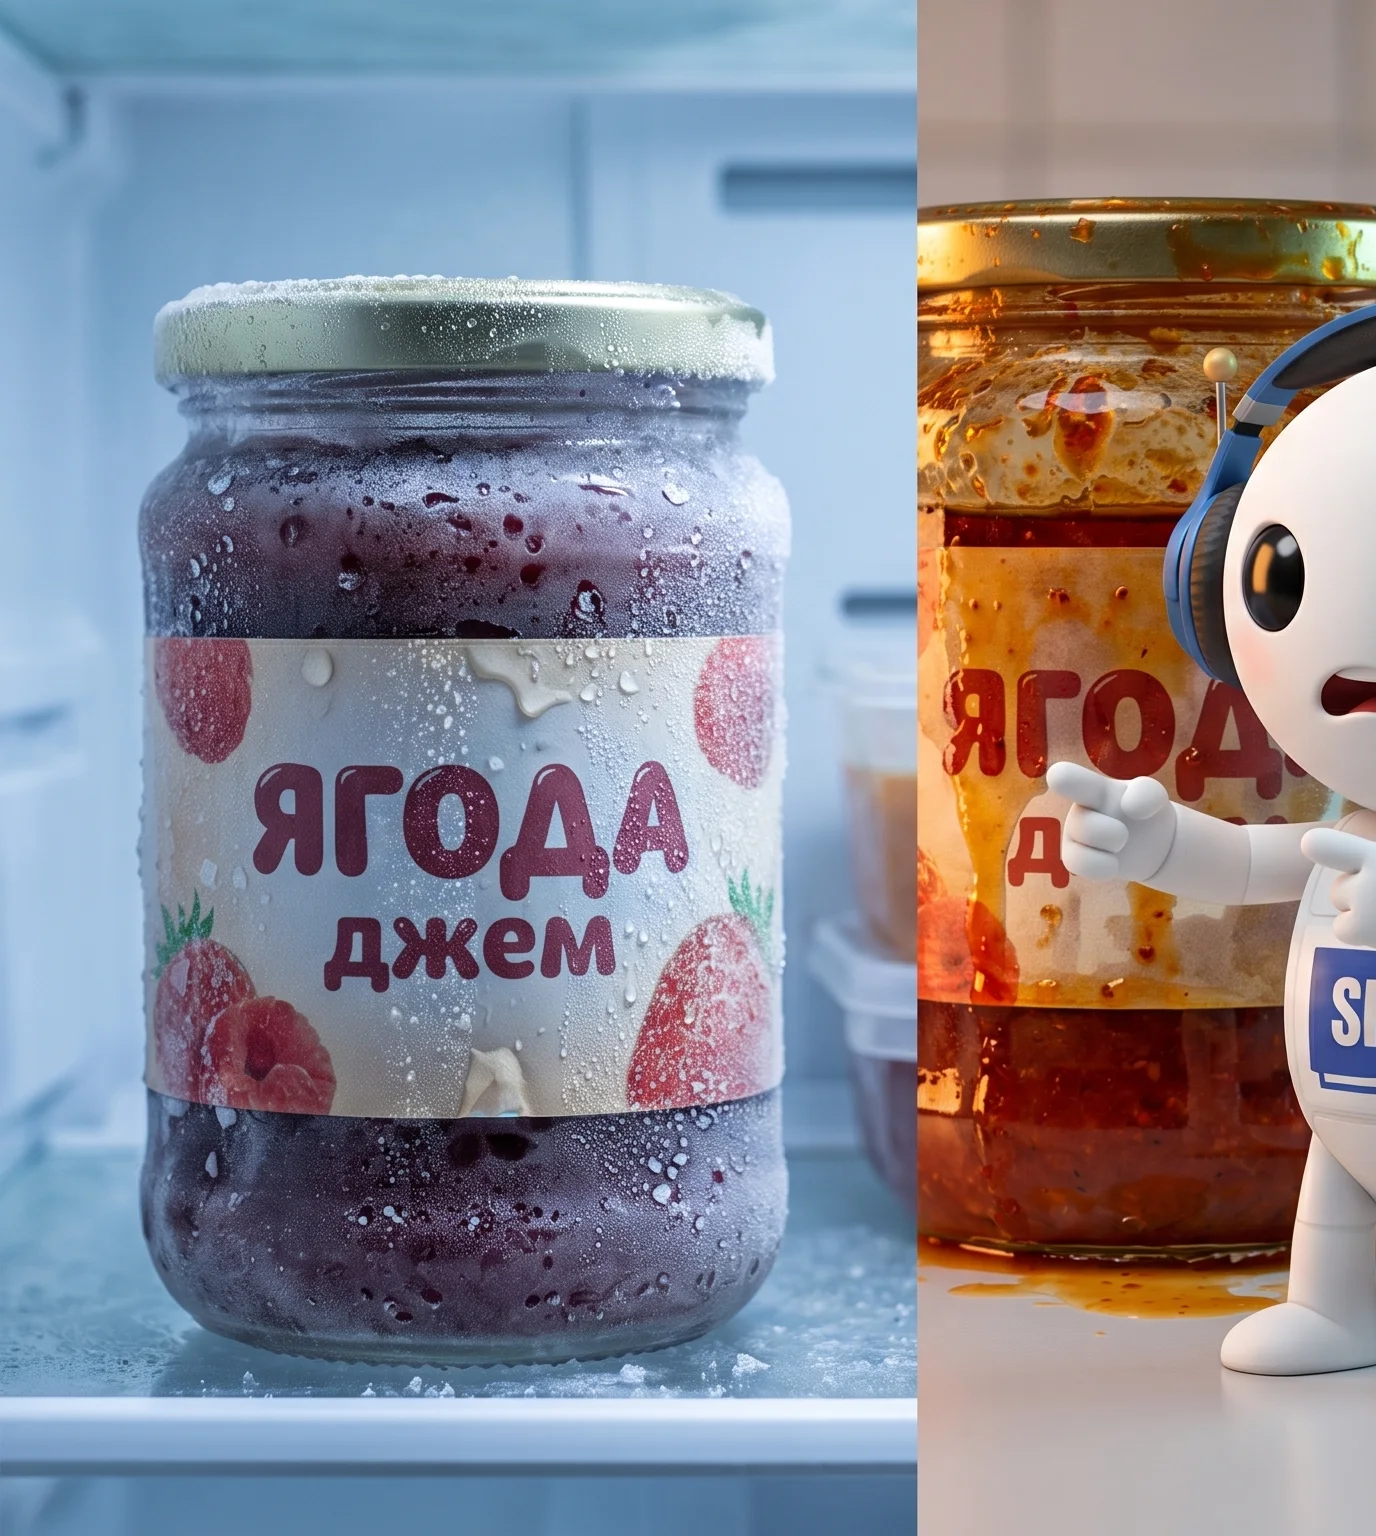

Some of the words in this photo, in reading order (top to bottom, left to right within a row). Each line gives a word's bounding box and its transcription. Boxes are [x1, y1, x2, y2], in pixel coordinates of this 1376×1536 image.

[943, 669, 1308, 801] ЯГОД
[253, 762, 690, 900] ЯГОДА
[323, 916, 617, 993] джем
